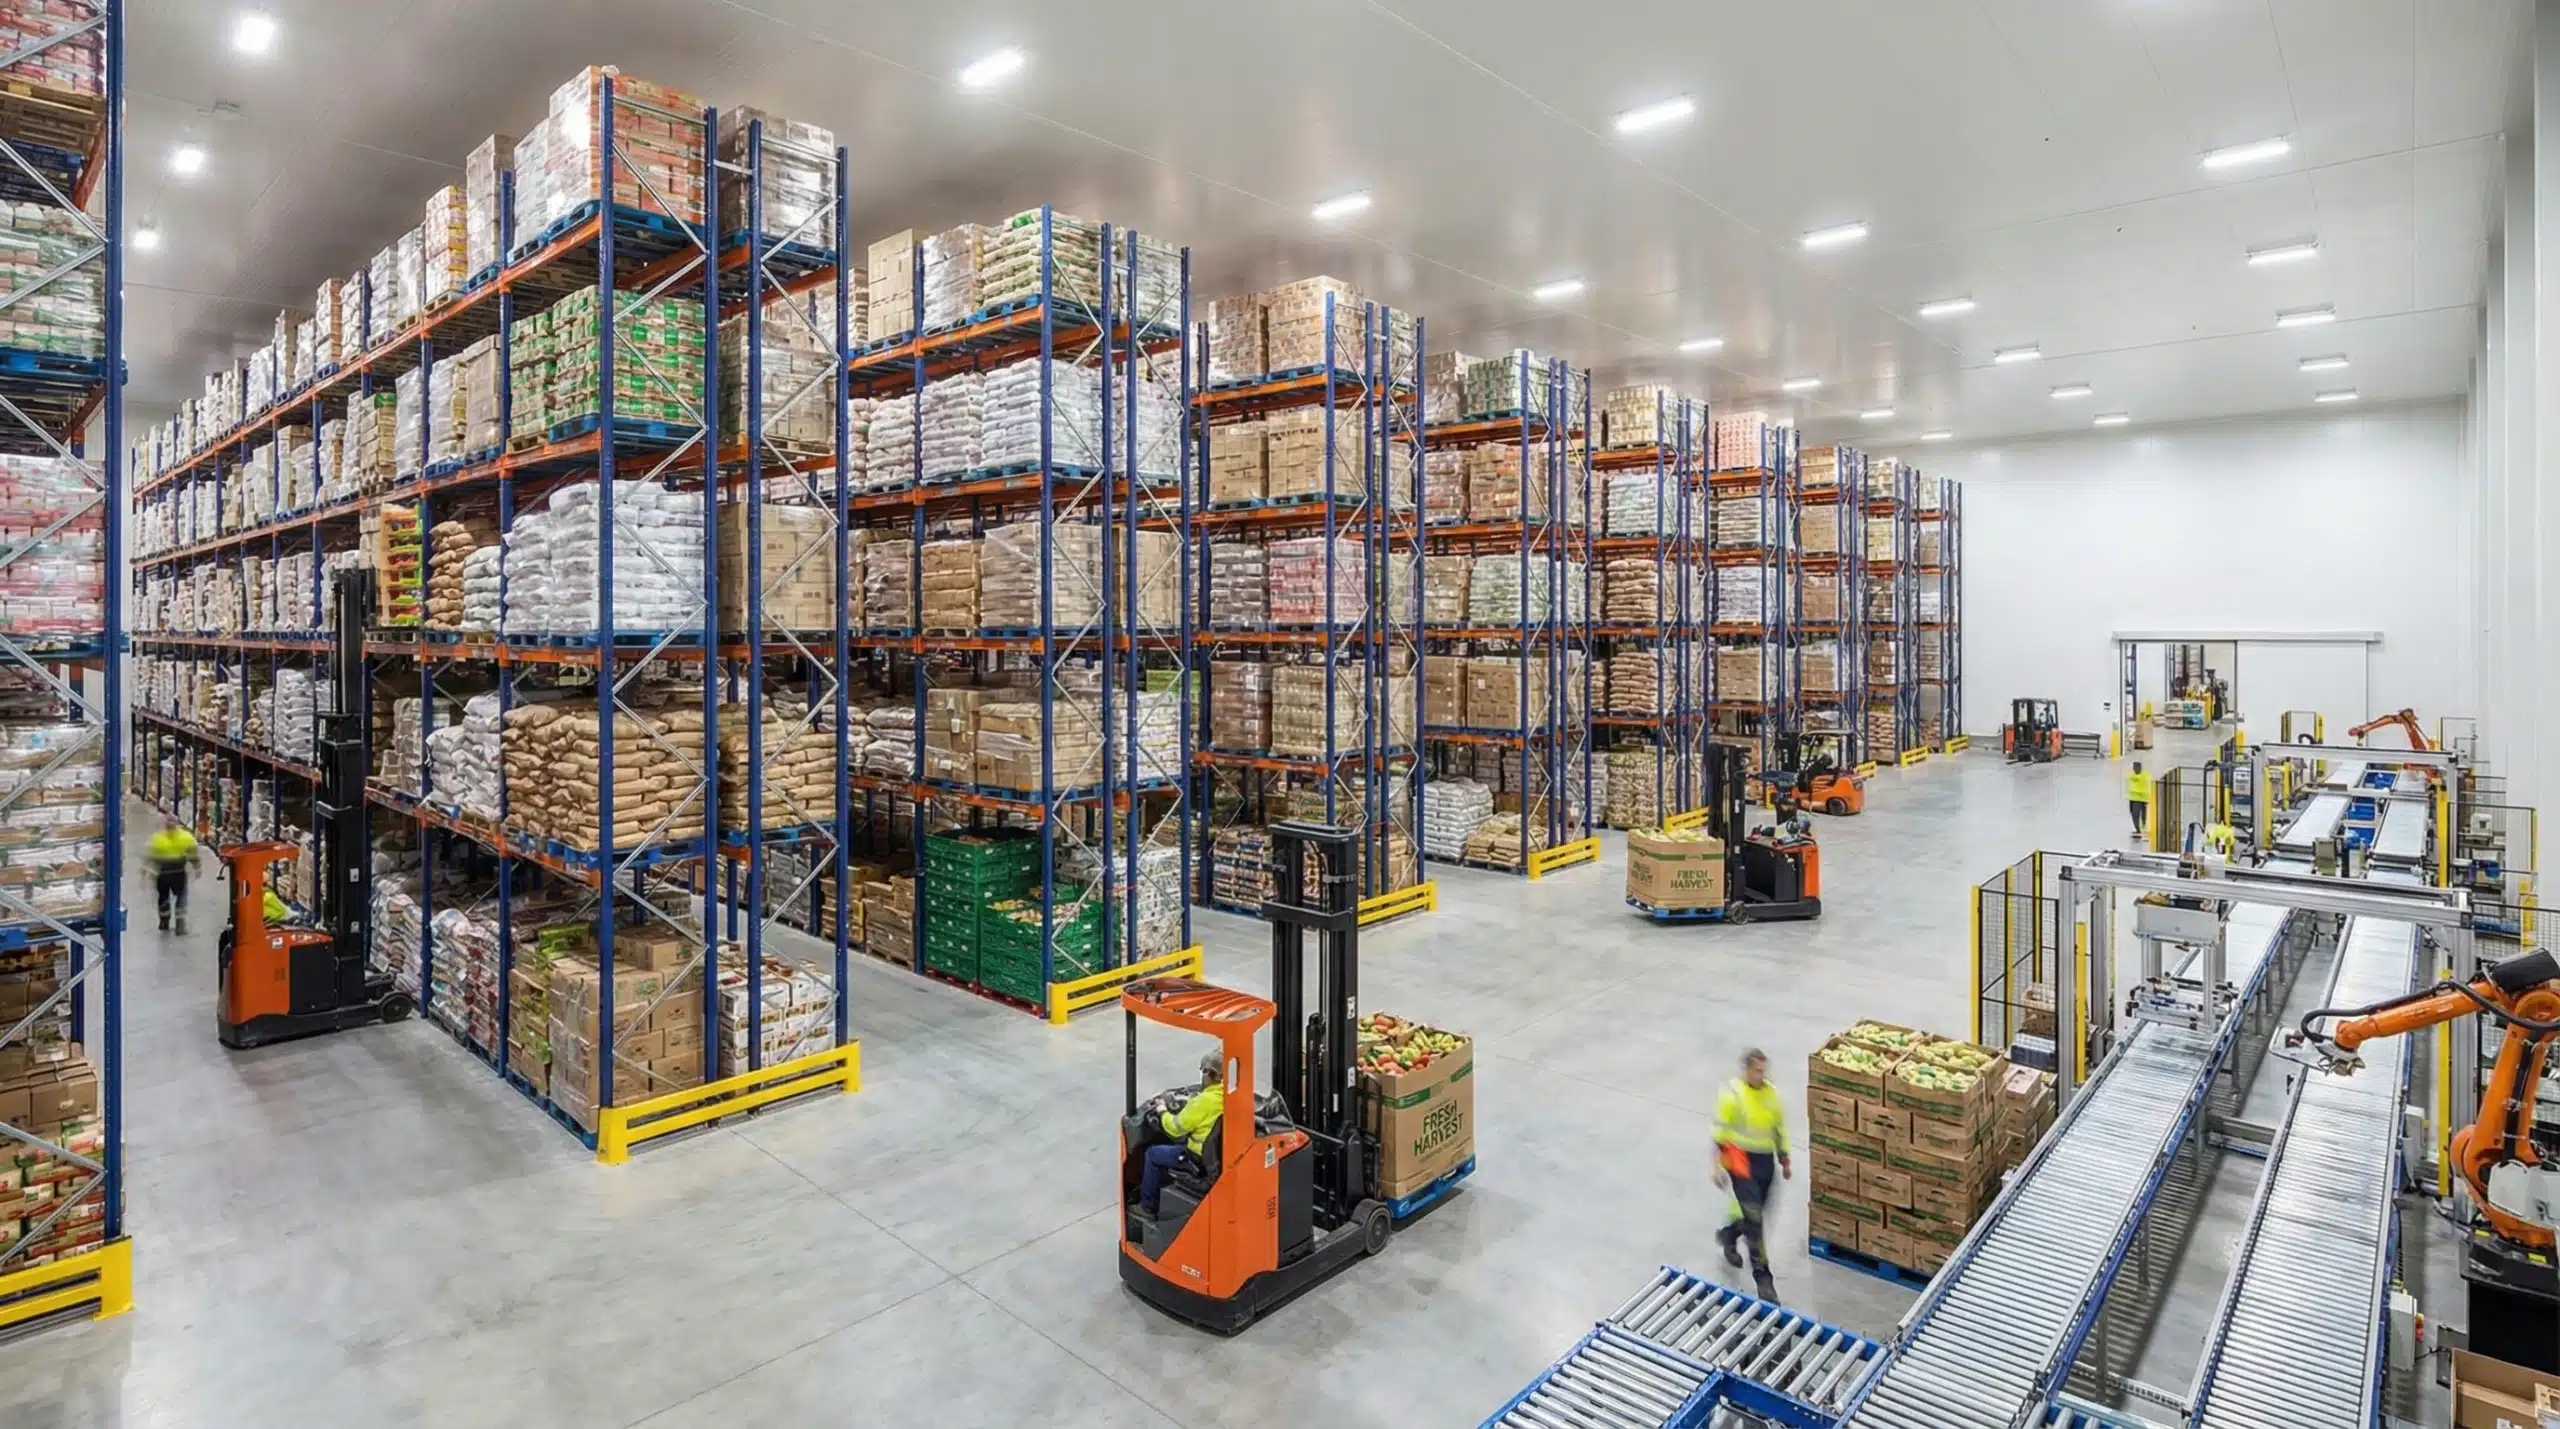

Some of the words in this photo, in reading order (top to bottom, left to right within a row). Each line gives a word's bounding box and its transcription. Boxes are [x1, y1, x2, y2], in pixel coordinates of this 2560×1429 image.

[1670, 879, 1714, 889] HARVEST
[1423, 1100, 1457, 1134] FRESH
[1414, 1113, 1464, 1156] HARVEST
